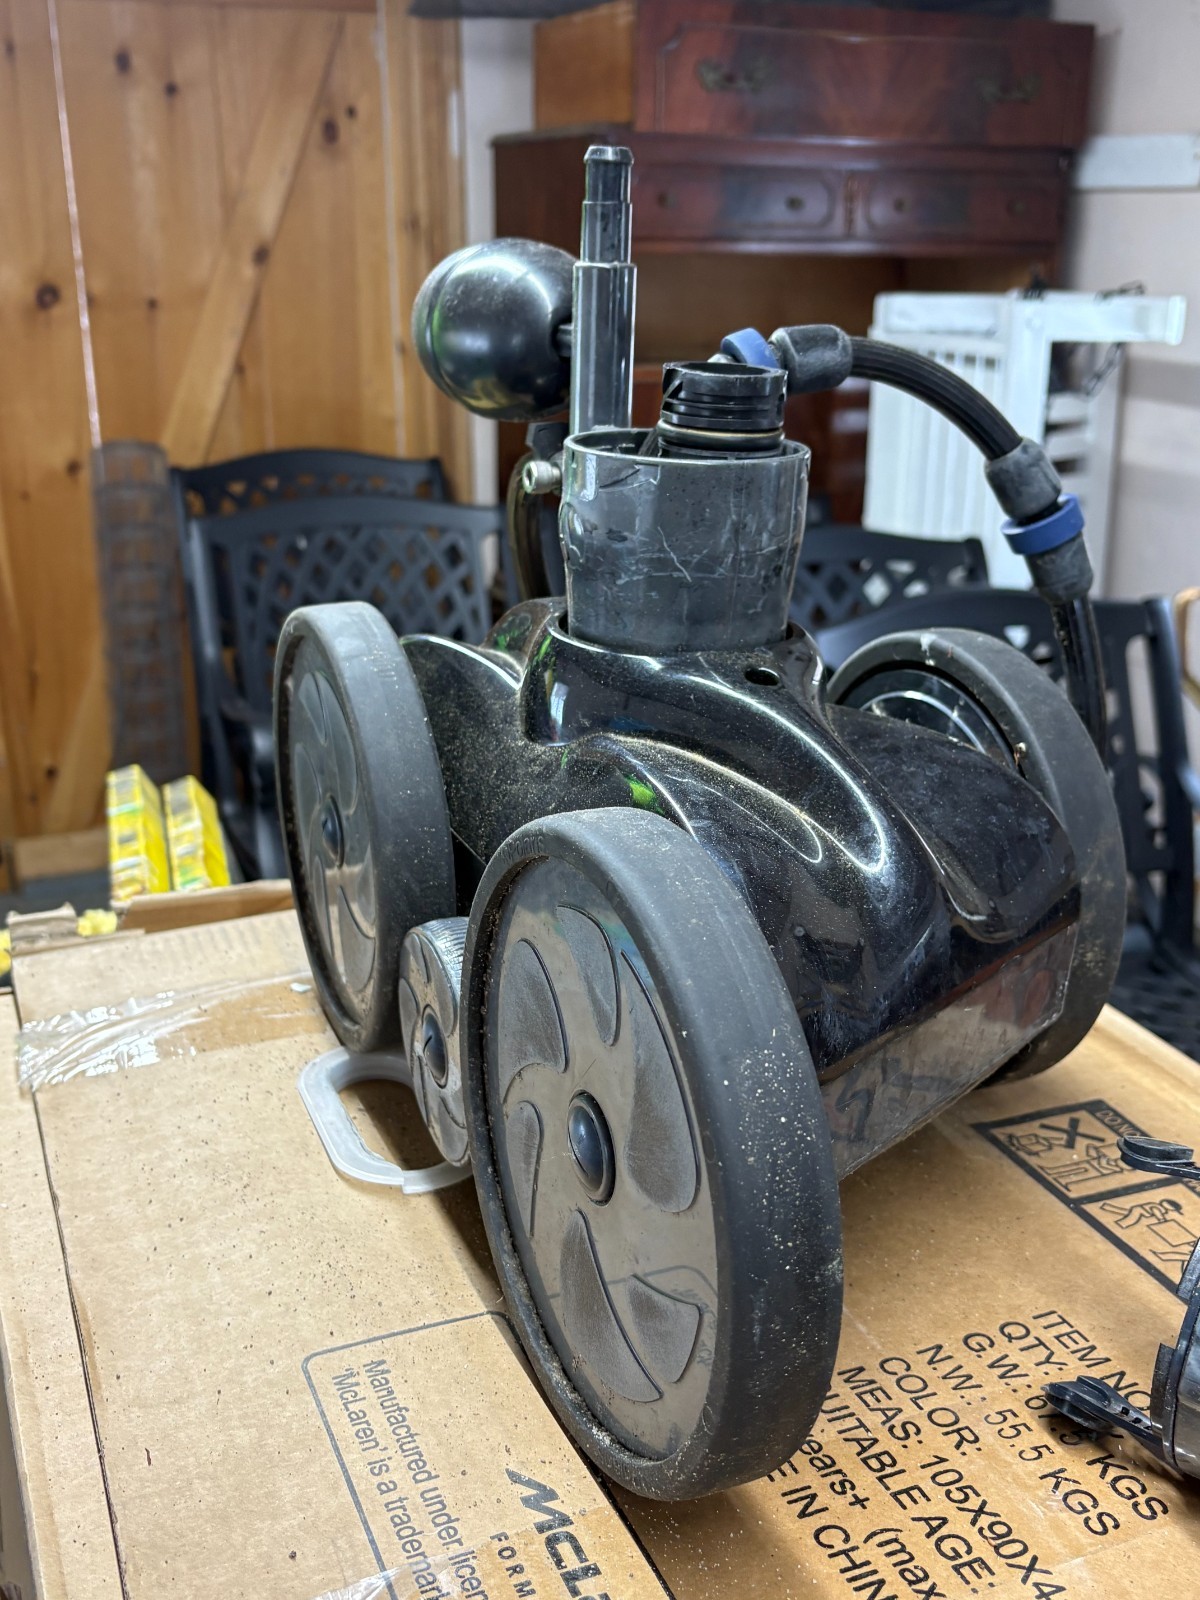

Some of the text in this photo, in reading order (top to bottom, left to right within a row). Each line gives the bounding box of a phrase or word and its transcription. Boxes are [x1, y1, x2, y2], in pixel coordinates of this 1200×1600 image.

[999, 1320, 1069, 1376] QTY:
[1031, 1309, 1112, 1369] ITEM
[836, 1364, 924, 1450] MEAS:
[878, 1355, 982, 1456] COLOR:
[916, 1342, 1121, 1537] N.W.: 55.5 KGS
[961, 1331, 1033, 1393] G.W.:
[1085, 1453, 1170, 1520] KGS
[362, 1358, 441, 1484] Manufactured
[419, 1486, 464, 1547] under
[366, 1456, 393, 1477] is
[376, 1479, 398, 1496] a
[801, 1434, 870, 1510] ears+
[780, 1484, 830, 1520] IN
[818, 1392, 996, 1595] UITABLE AGE:
[489, 1531, 537, 1598] FORM
